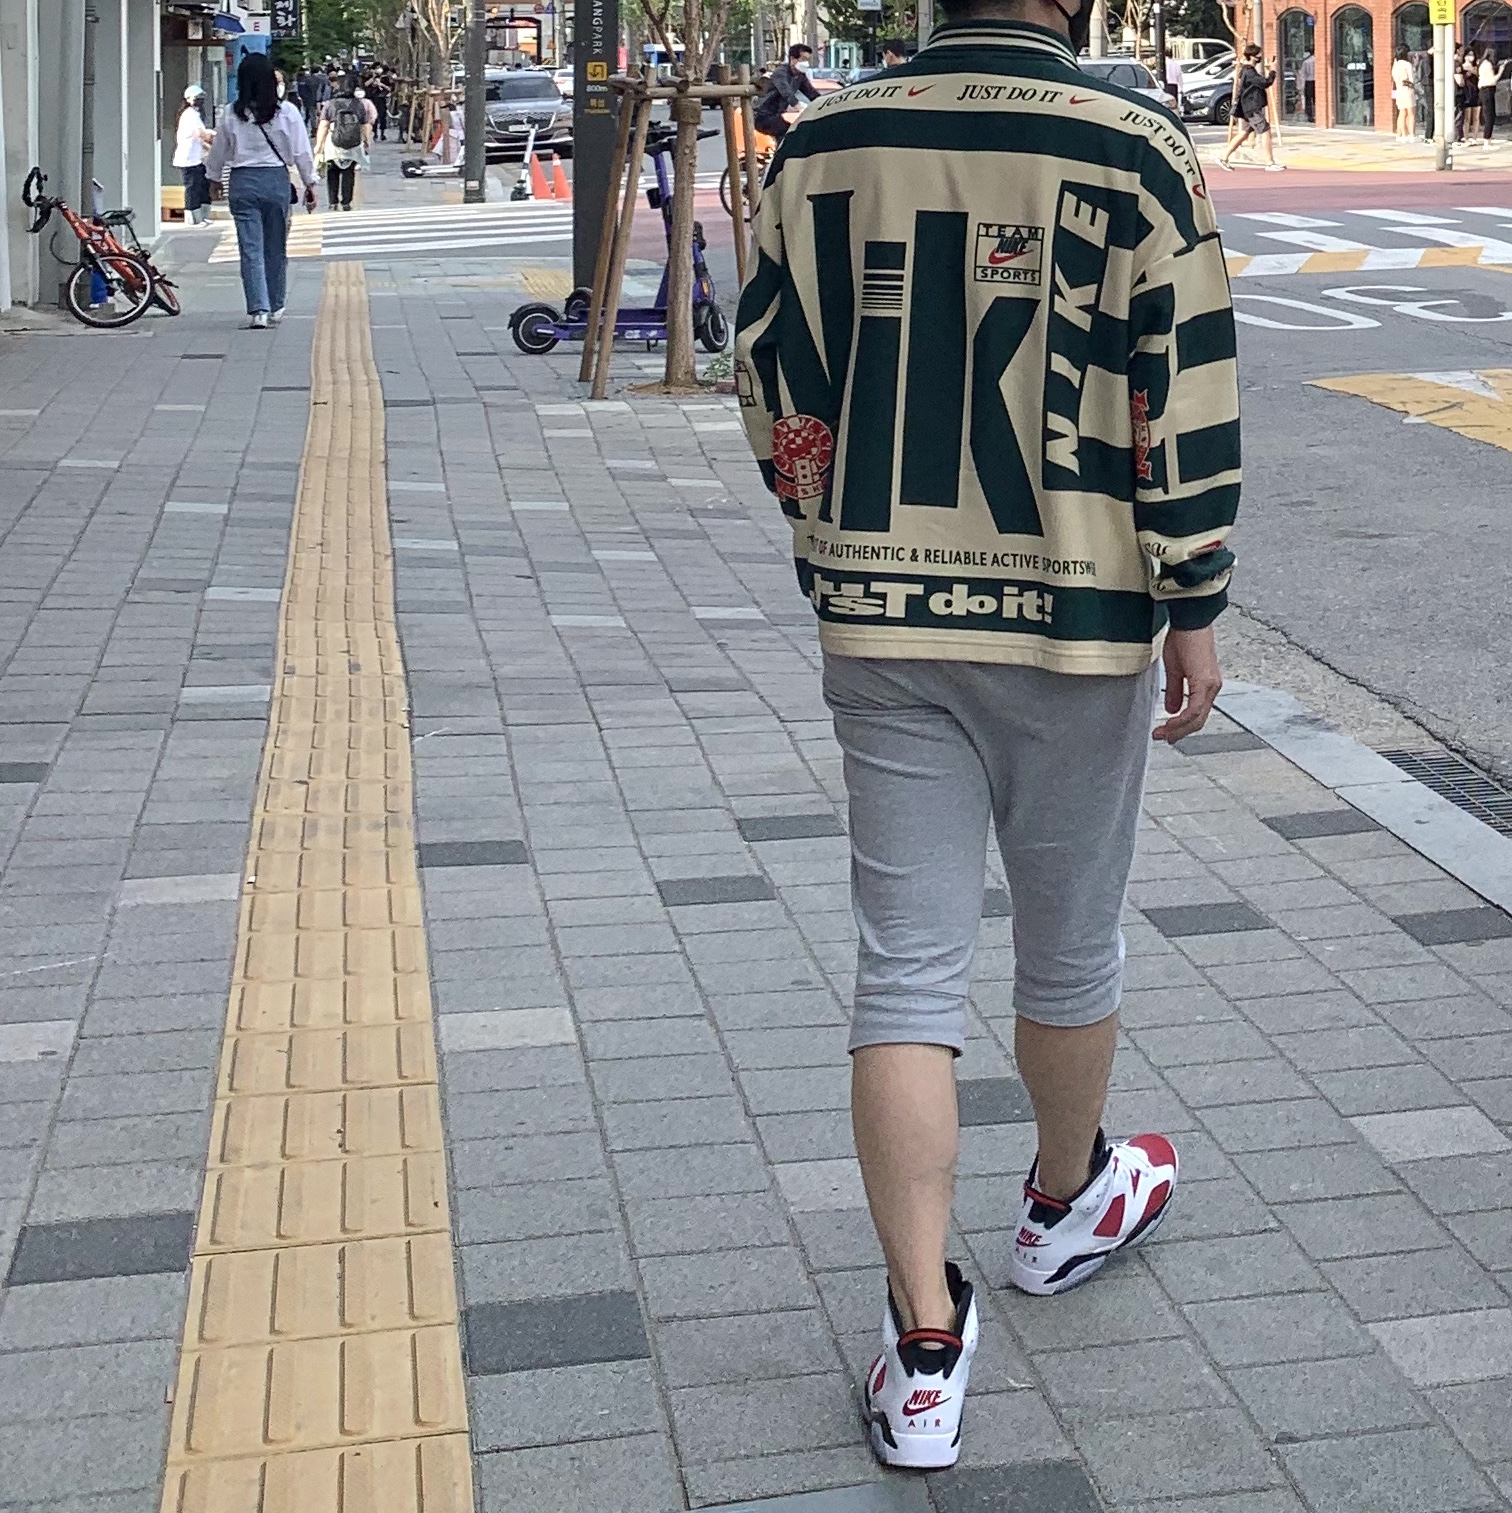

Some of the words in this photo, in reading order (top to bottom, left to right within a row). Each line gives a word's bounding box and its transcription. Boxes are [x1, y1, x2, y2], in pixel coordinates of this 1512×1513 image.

[818, 90, 856, 110] JUST
[853, 87, 881, 100] DO
[881, 86, 902, 98] IT
[957, 85, 1006, 100] JUST
[1006, 87, 1037, 101] DO
[1039, 90, 1063, 103] IT
[1120, 110, 1167, 135] JUST
[1163, 135, 1186, 157] DO
[982, 223, 1039, 240] TEAM
[996, 237, 1029, 254] NIKE
[980, 268, 1037, 282] SPORTS
[1046, 190, 1109, 477] NIKE
[828, 543, 906, 562] AUTHENTIC
[910, 548, 919, 563] &
[924, 548, 987, 567] RELIABLE
[991, 552, 1039, 570] ACTIVE
[928, 583, 998, 617] do
[1002, 586, 1054, 625] it!
[1018, 1225, 1042, 1245] NIKE
[908, 1389, 942, 1406] NIKE
[907, 1419, 941, 1428] AIR
